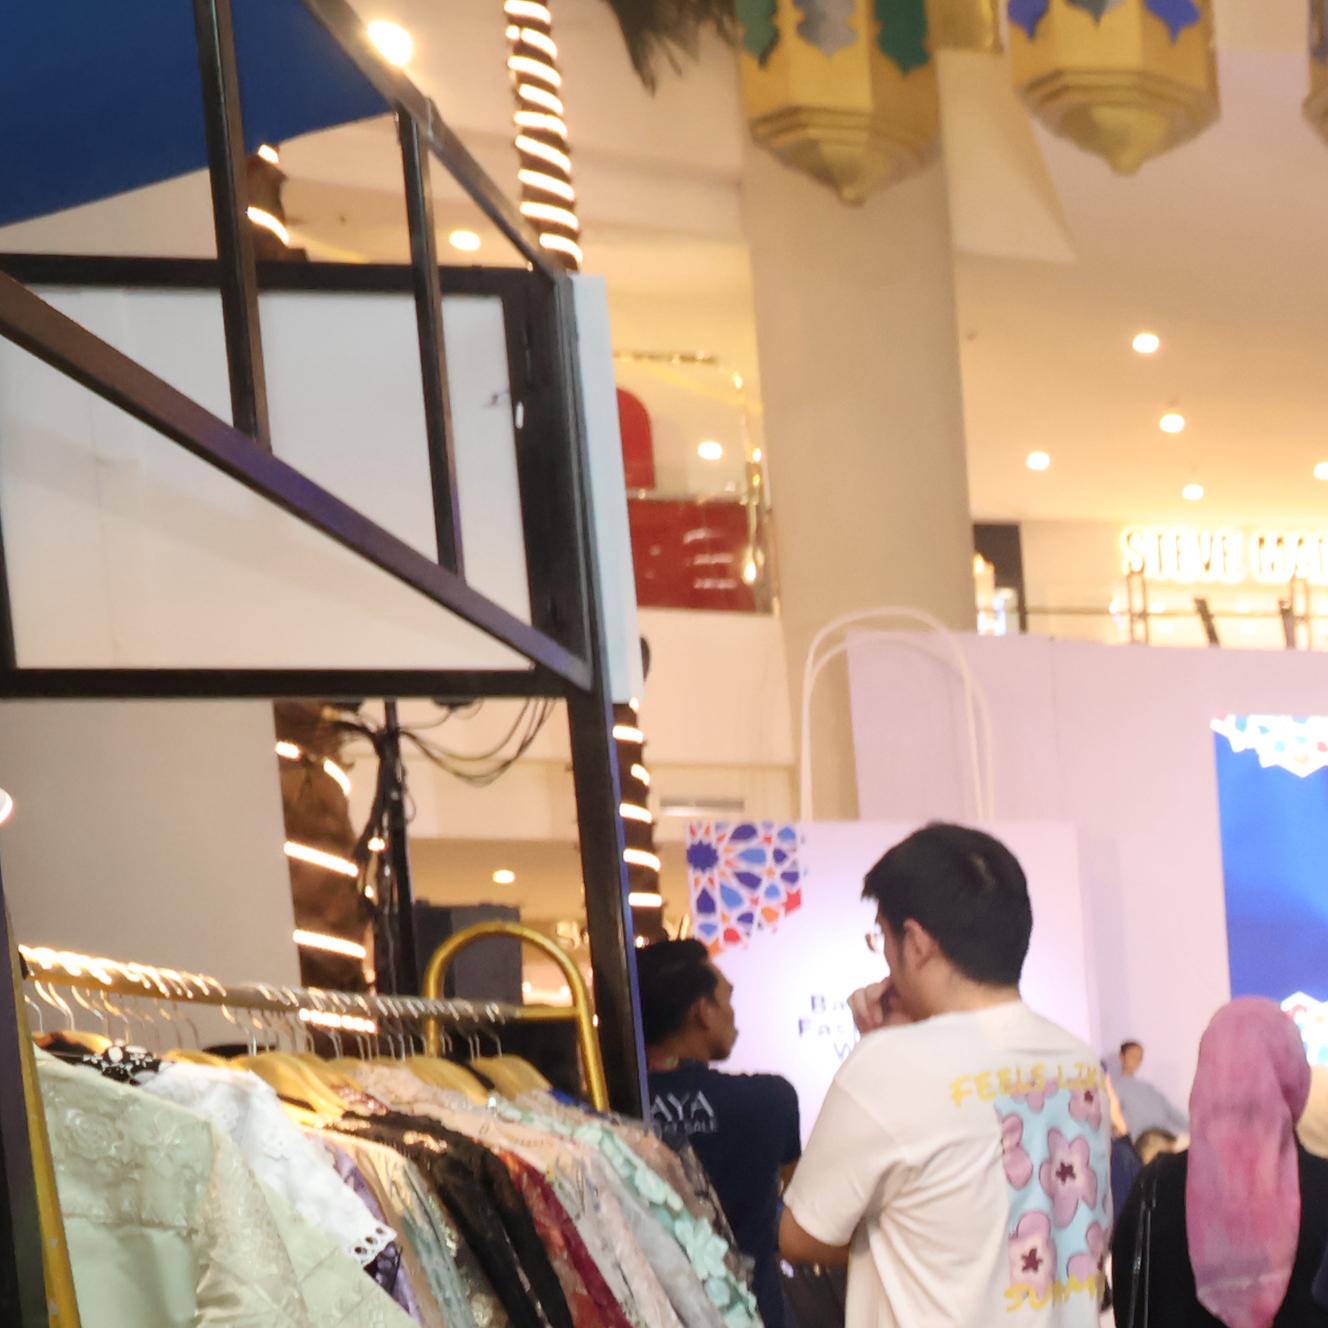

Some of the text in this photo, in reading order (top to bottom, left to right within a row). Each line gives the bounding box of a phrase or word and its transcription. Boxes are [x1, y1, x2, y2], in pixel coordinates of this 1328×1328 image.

[1121, 528, 1242, 579] STEVE
[650, 1089, 715, 1122] AYA
[949, 1063, 1045, 1108] FEELS
